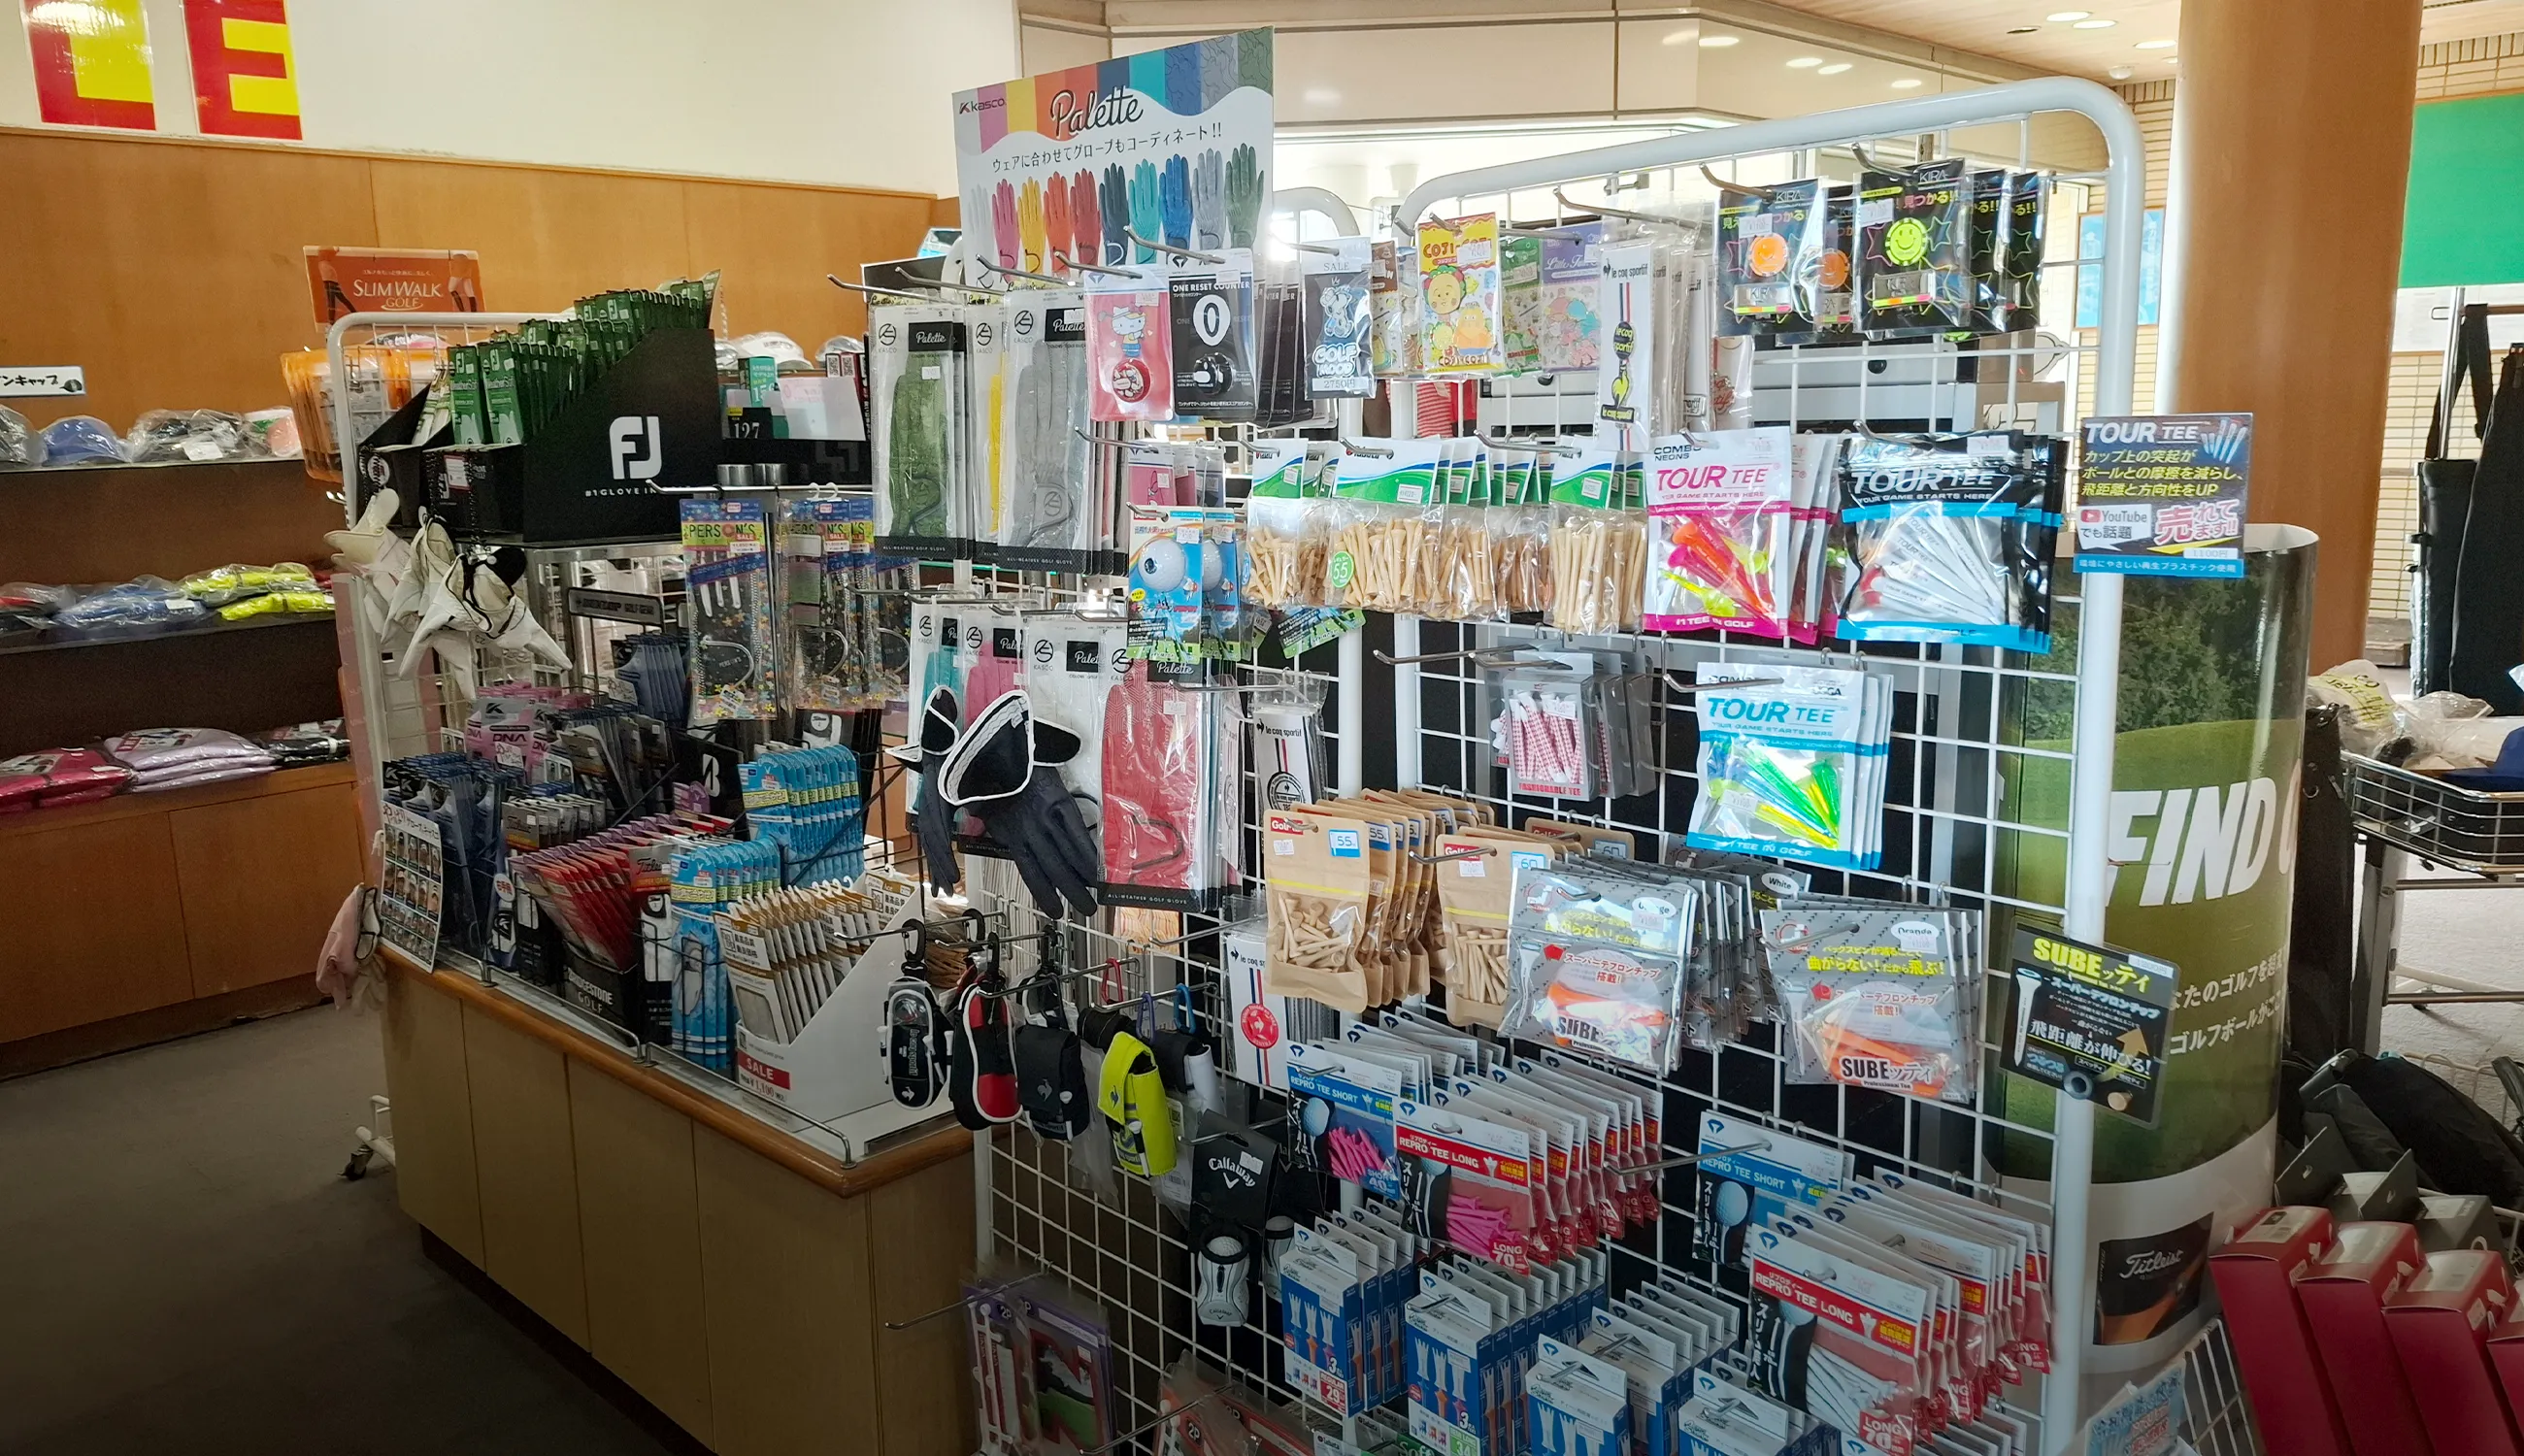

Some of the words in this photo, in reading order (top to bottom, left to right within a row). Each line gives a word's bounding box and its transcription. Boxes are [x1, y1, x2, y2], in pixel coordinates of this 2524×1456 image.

[970, 98, 1006, 112] kasco
[1049, 85, 1144, 139] Palette
[1919, 170, 1948, 182] KIRA
[1323, 262, 1350, 271] SALE
[1611, 268, 1617, 279] le
[1629, 264, 1648, 279] sportif
[353, 279, 393, 297] SLIM
[394, 281, 442, 297] WALK
[1190, 282, 1212, 291] RESET
[1213, 281, 1250, 290] COUNTER
[385, 297, 419, 308] GOLF
[915, 330, 946, 344] Palette
[2083, 421, 2158, 444] TOUR
[2161, 425, 2200, 440] TEE
[609, 415, 662, 480] FJ
[2083, 448, 2198, 464] カップ上の突起が
[1656, 466, 1727, 491] TOUR
[1732, 468, 1769, 483] TEE
[1850, 468, 1943, 495] TOUR
[1945, 470, 1996, 487] TEE
[2081, 466, 2243, 480] ボールとの摩擦を減らし、
[2080, 482, 2220, 497] 飛距離と方向性をUP
[2102, 510, 2147, 523] YouTube
[689, 523, 755, 539] PERSON'S
[2080, 525, 2133, 540] でも話題
[1897, 537, 1919, 556] TOUR
[1334, 561, 1348, 579] 55
[1687, 615, 1710, 624] TEE
[1724, 618, 1755, 628] GOLF
[1156, 661, 1194, 675] Palette
[1707, 697, 1791, 723] TOUR
[1795, 707, 1835, 723] TEE
[492, 733, 527, 743] DNA
[1519, 781, 1567, 795] FASHIONABLE
[1569, 785, 1581, 796] TEE
[1337, 836, 1352, 846] 55
[1369, 826, 1384, 840] 55
[1737, 841, 1759, 849] TEE
[1778, 846, 1813, 857] GOLF
[2106, 777, 2276, 908] FIND
[1520, 857, 1539, 869] 60
[1769, 876, 1792, 890] White
[1107, 893, 1147, 902] ALL-WEATHER
[1166, 896, 1188, 906] GLOVE
[1246, 957, 1258, 967] coq
[1564, 954, 1661, 978] スーパーテフロンチップ
[2032, 938, 2150, 994] SUBEッティ
[567, 965, 614, 1007] BRIDGESTONE
[578, 992, 604, 1014] GOLF
[2030, 1018, 2152, 1075] 飛距離が伸びる!
[746, 1056, 775, 1081] SALE
[1841, 1057, 1934, 1084] SUBEッティ
[1290, 1075, 1316, 1090] REPRO
[1316, 1082, 1331, 1096] TEE
[1331, 1088, 1359, 1104] SHORT
[1399, 1136, 1429, 1153] REPRO
[1430, 1146, 1449, 1160] TEE
[1451, 1151, 1479, 1169] LONG
[1209, 1155, 1256, 1188] Callaway
[1701, 1157, 1732, 1173] REPRO
[1734, 1165, 1751, 1179] TEE
[1753, 1172, 1786, 1190] SHORT
[1369, 1176, 1387, 1191] 40
[1493, 1241, 1523, 1254] LONG
[1492, 1250, 1514, 1268] 70
[2118, 1248, 2184, 1279] Titleist
[1755, 1272, 1792, 1297] REPRO
[1794, 1289, 1818, 1308] TEE
[1820, 1301, 1854, 1325] LONG
[1325, 1385, 1341, 1404] 29
[1865, 1415, 1903, 1437] LONG
[1861, 1425, 1892, 1451] 70
